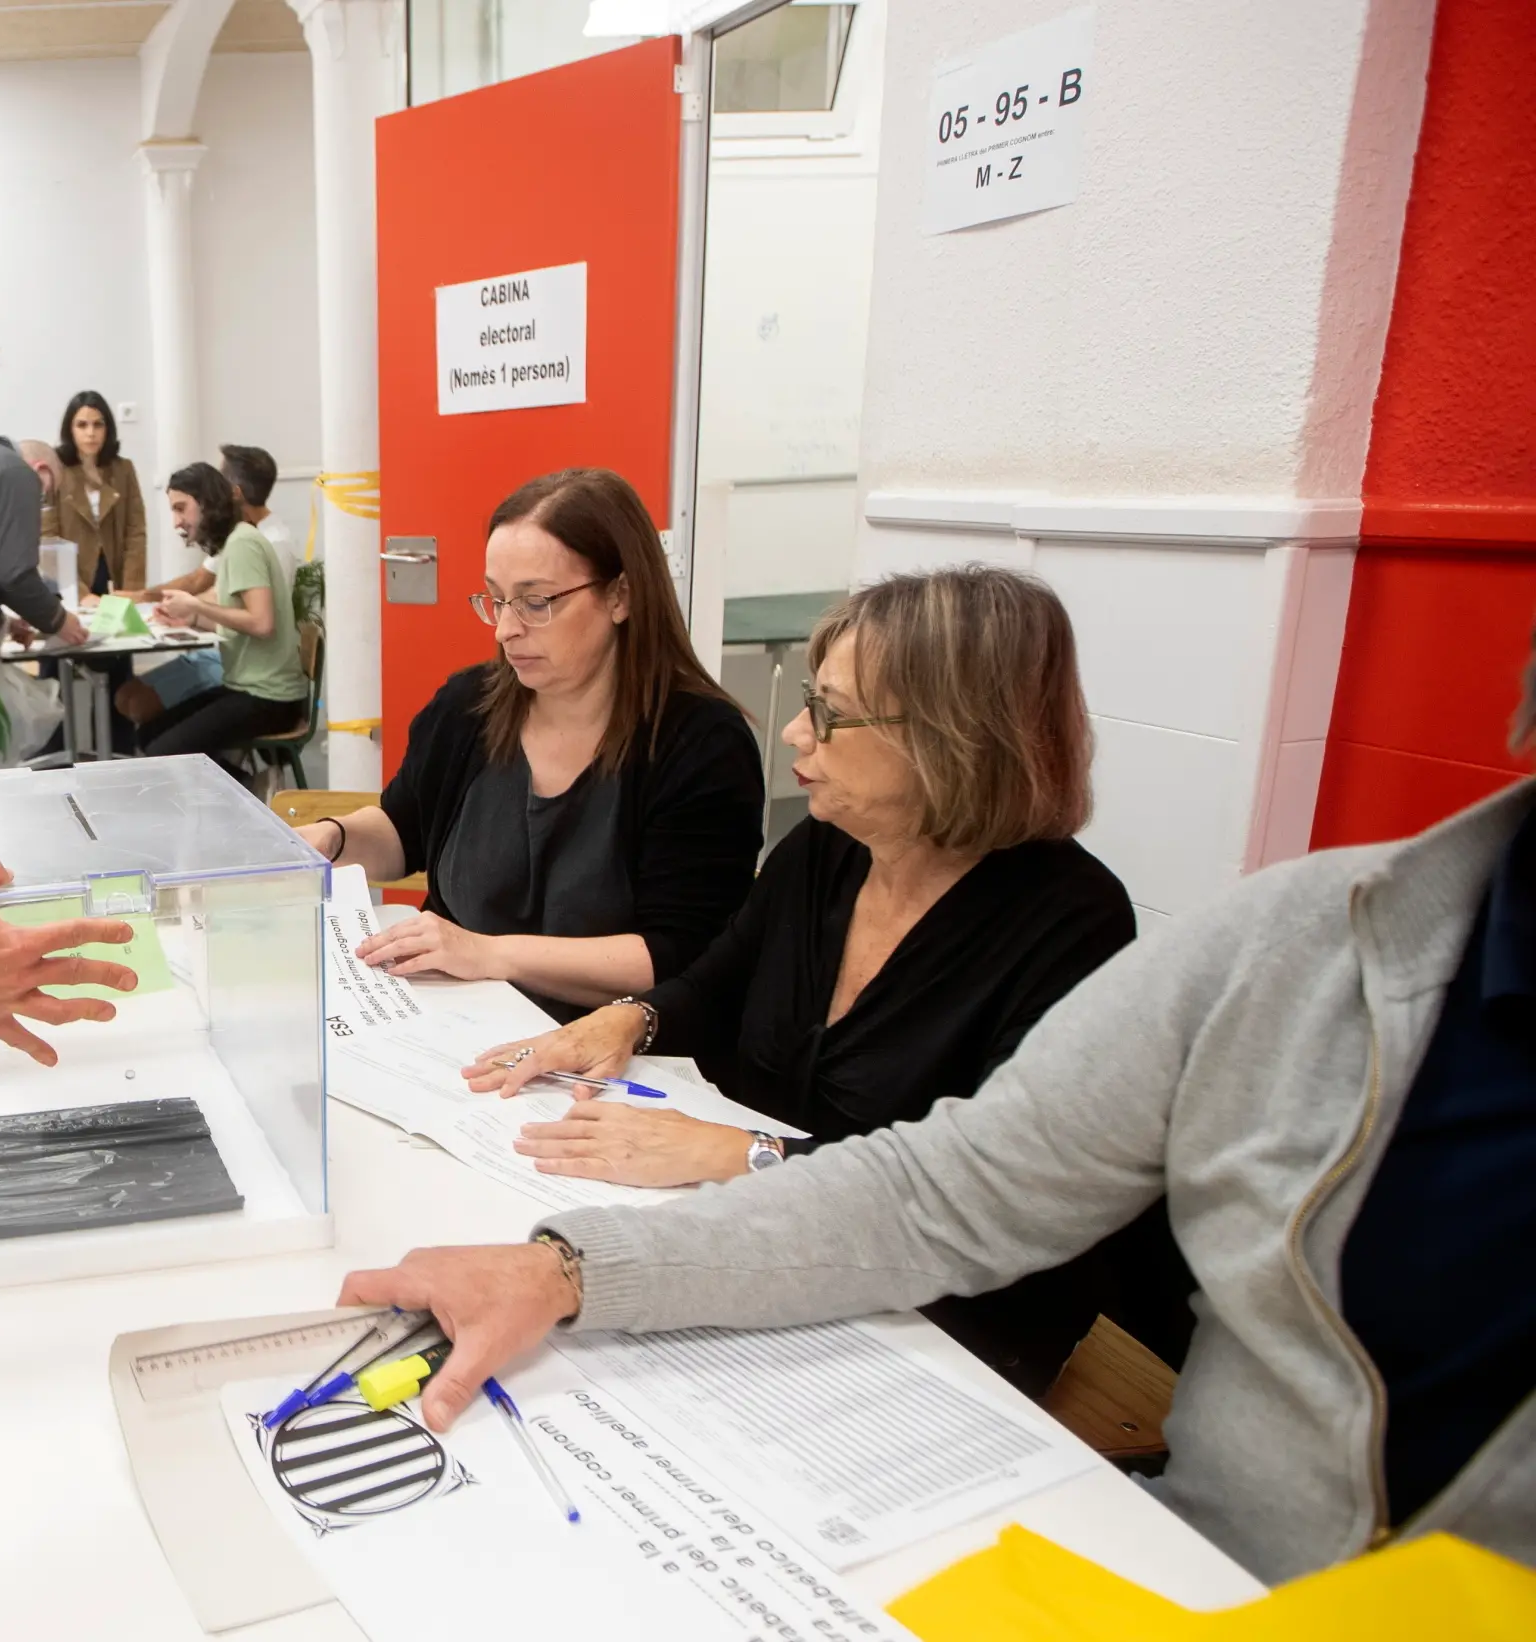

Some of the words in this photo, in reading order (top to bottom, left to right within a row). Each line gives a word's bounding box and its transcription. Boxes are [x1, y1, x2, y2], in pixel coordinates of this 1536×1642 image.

[938, 104, 969, 144] 05
[977, 115, 986, 124] -
[995, 84, 1029, 126] 95
[1038, 95, 1049, 105] -
[1058, 67, 1082, 107] B
[987, 140, 1009, 153] PRIMER
[1009, 132, 1037, 146] COGNOM
[975, 163, 992, 189] M
[1008, 155, 1023, 180] Z
[480, 279, 530, 307] CABINA
[479, 318, 536, 347] electoral
[500, 362, 506, 384] 1
[511, 355, 570, 388] persona)
[326, 915, 350, 954] cognom)
[354, 909, 373, 937] ellido)
[344, 955, 366, 981] primer
[565, 1389, 649, 1449] apellido)
[528, 1415, 612, 1482] cognom)
[645, 1453, 723, 1504] primer
[610, 1484, 687, 1539] primer
[710, 1508, 755, 1535] del
[638, 1539, 662, 1559] la
[676, 1543, 720, 1573] del
[710, 1535, 736, 1552] la
[662, 1561, 680, 1574] a
[735, 1555, 756, 1568] a
